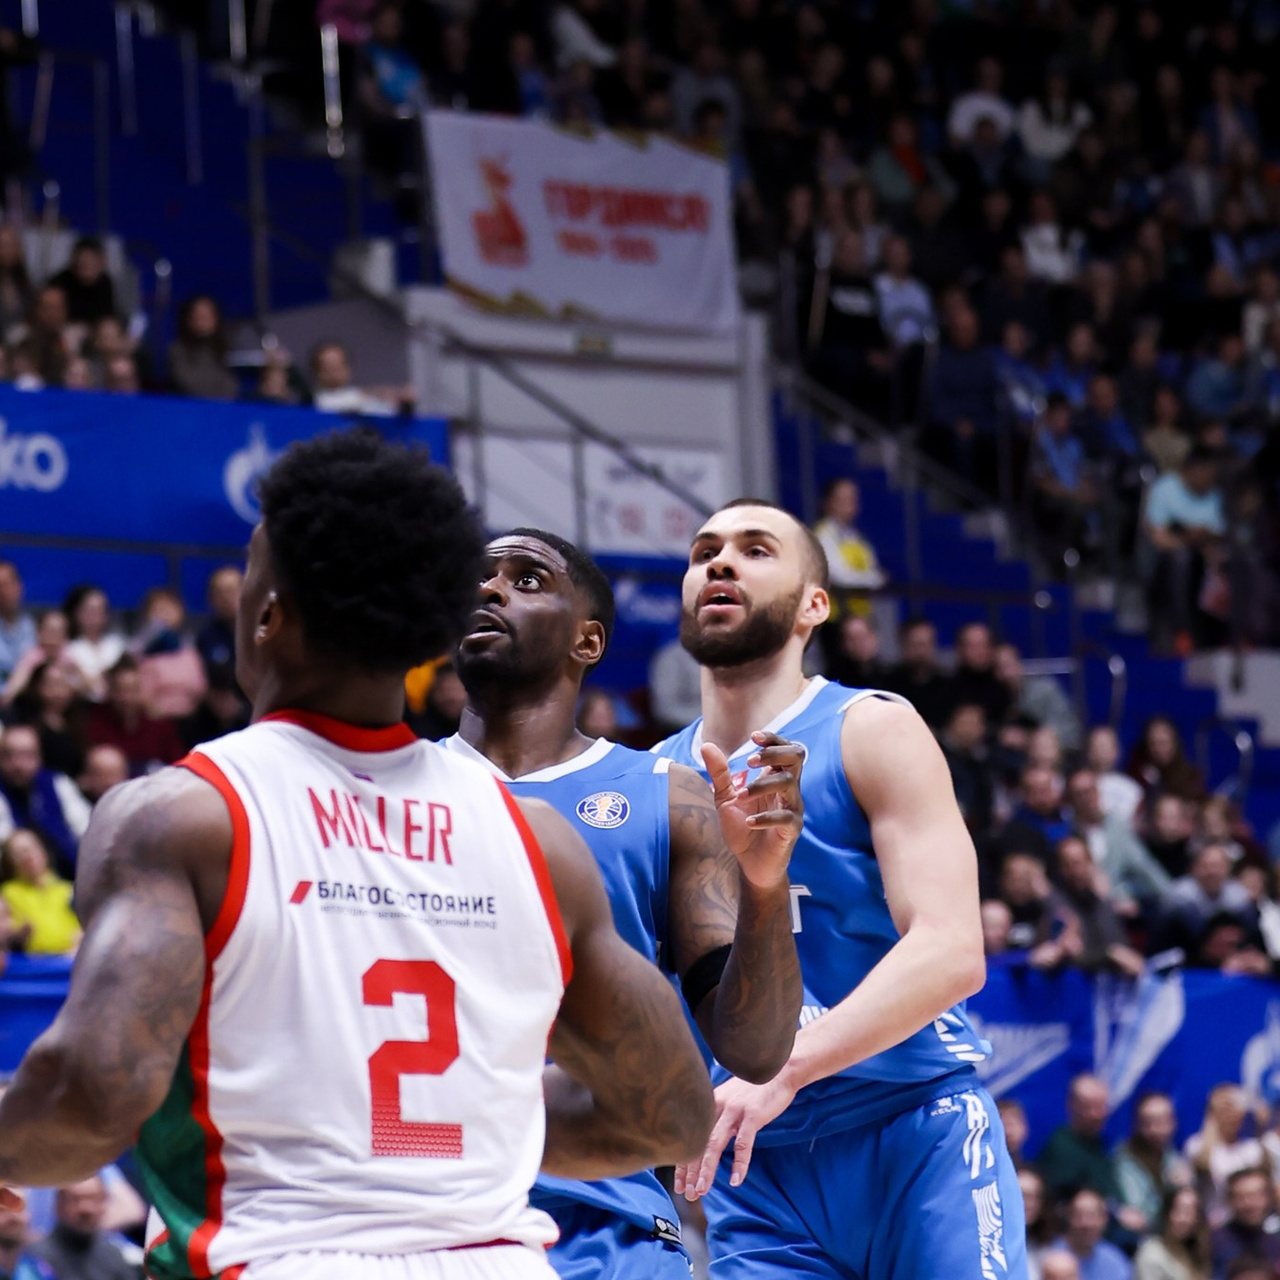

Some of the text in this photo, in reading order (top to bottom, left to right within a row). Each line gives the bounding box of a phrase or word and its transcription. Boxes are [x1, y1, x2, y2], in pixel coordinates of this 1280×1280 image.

[307, 786, 454, 866] MILLER
[318, 880, 497, 915] БЛАГОССТОЯНИЕ
[362, 958, 463, 1159] 2
